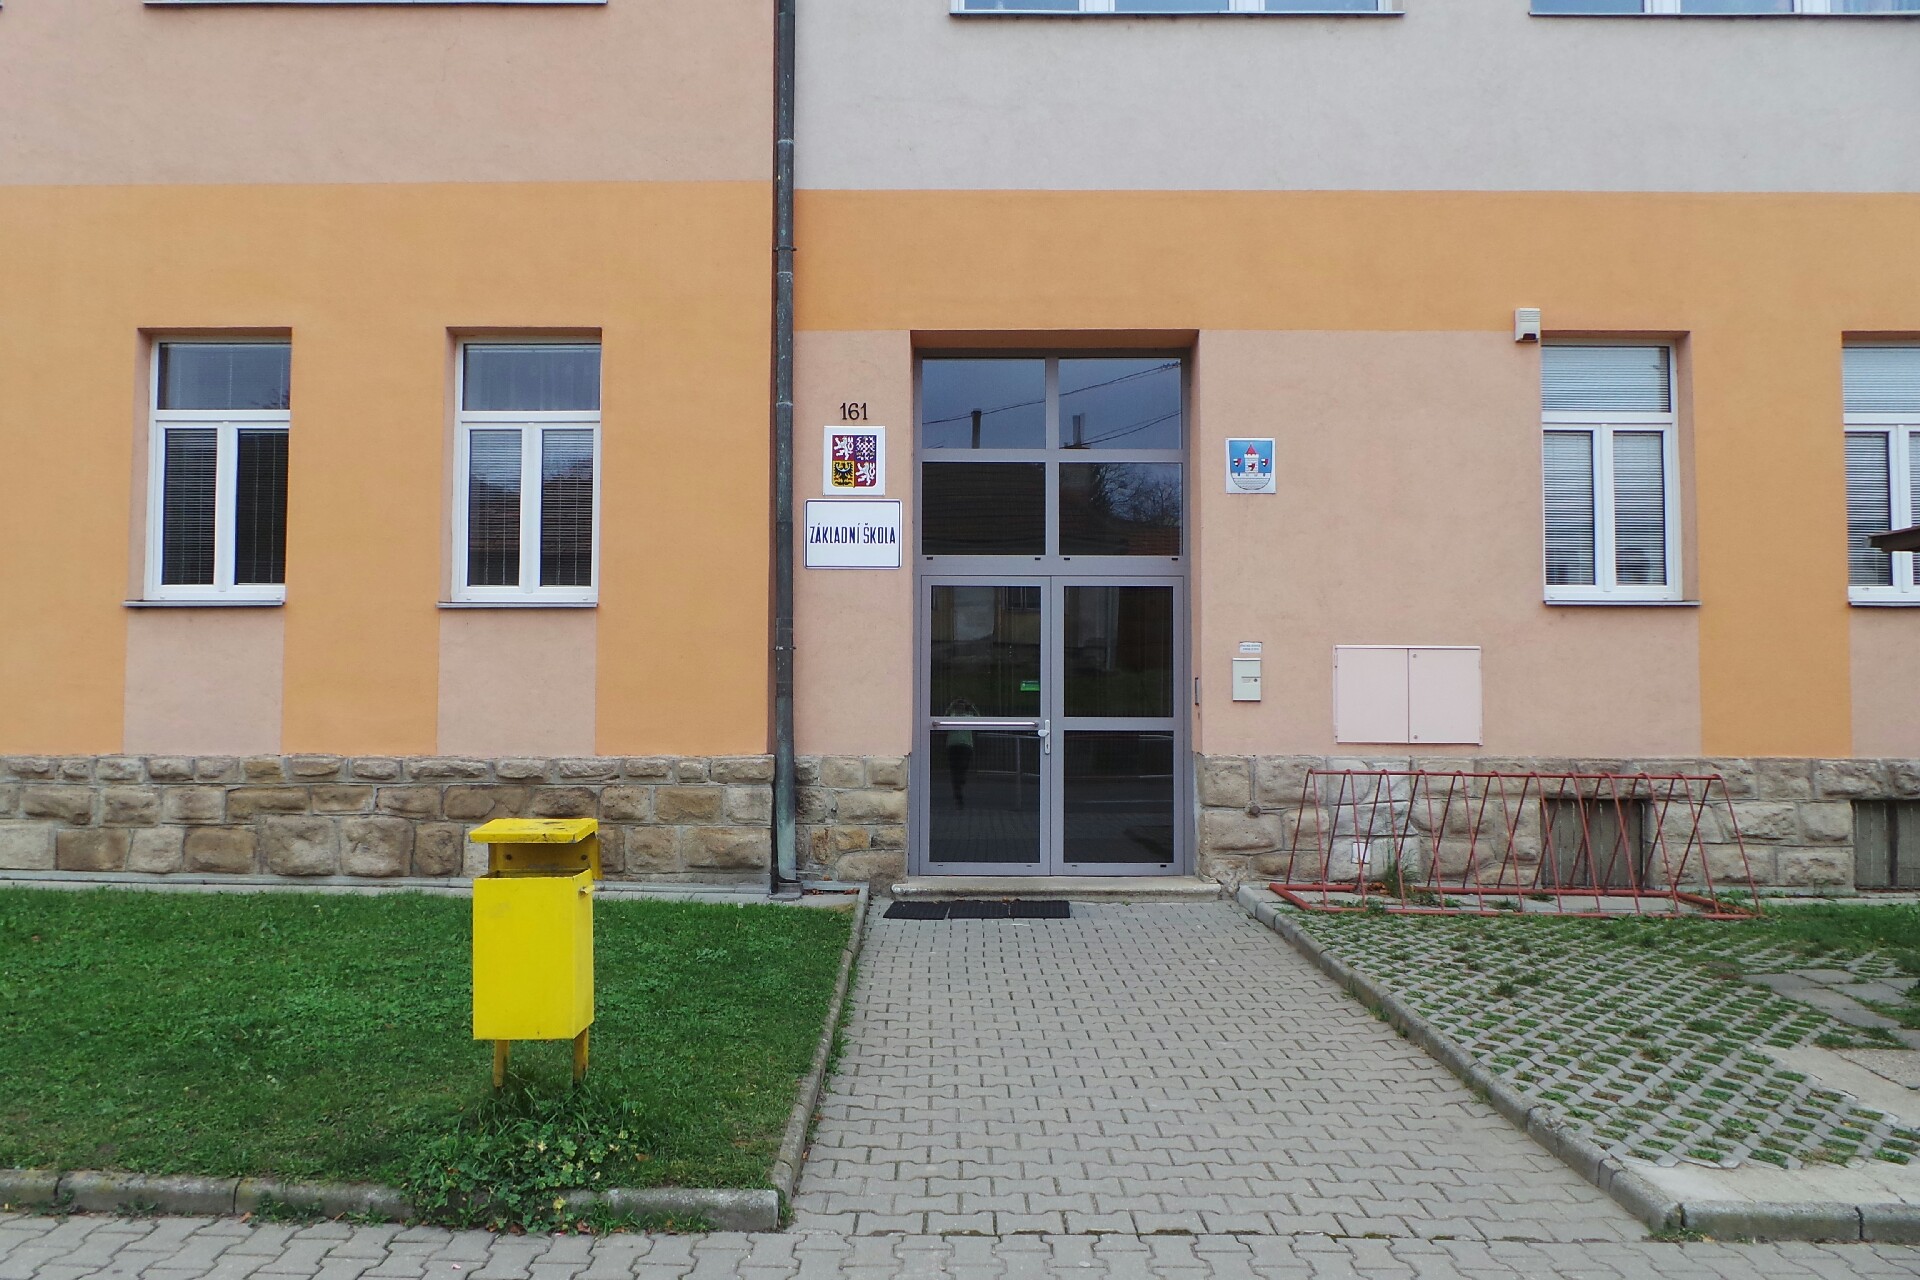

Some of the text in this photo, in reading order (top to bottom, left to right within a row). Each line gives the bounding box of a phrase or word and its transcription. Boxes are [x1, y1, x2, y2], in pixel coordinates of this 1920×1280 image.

[839, 402, 868, 421] 161
[809, 522, 896, 544] ZÁKLADNÍ ŠKOLA
